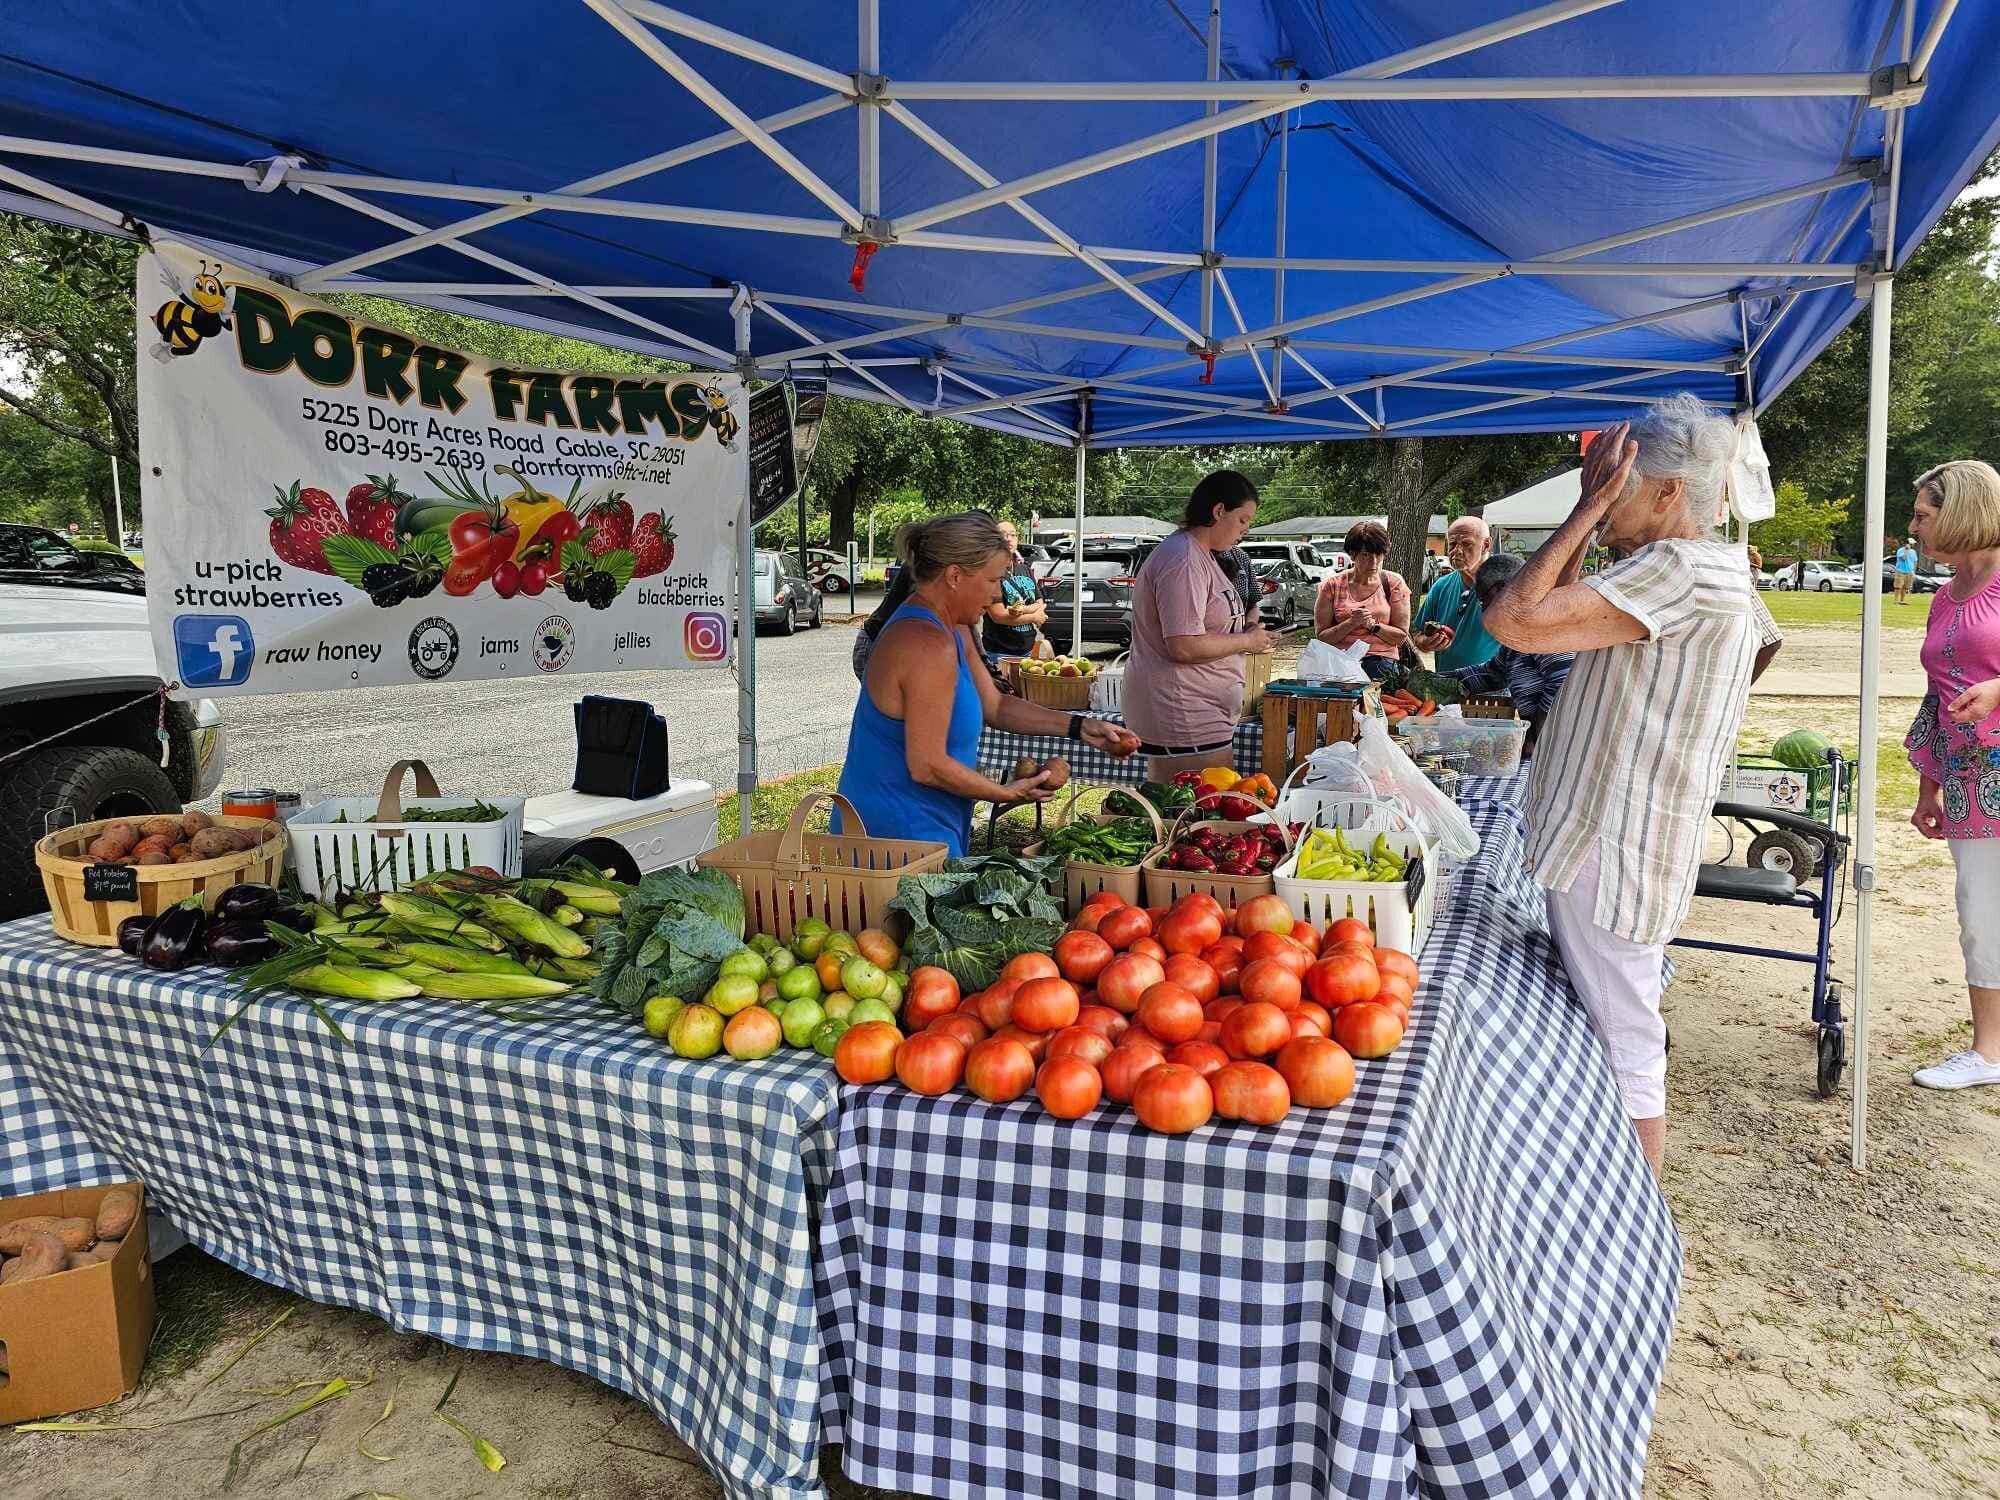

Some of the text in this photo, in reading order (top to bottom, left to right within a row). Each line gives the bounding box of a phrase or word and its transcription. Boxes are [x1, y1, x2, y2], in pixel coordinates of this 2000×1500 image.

[231, 283, 709, 442] DORR FARMS
[302, 397, 686, 465] 5225 Dorr Acres Road Gable, SC 29051
[324, 429, 671, 485] 803-495-2639 dorrfarms@ftc-i.net
[195, 558, 282, 585] u-pick
[663, 572, 708, 590] u-pick
[174, 583, 343, 608] strawberries
[637, 587, 725, 606] blackberries
[538, 618, 570, 636] CERTIFIED
[265, 640, 382, 664] raw honey
[480, 636, 519, 658] jams
[613, 631, 651, 652] jellies
